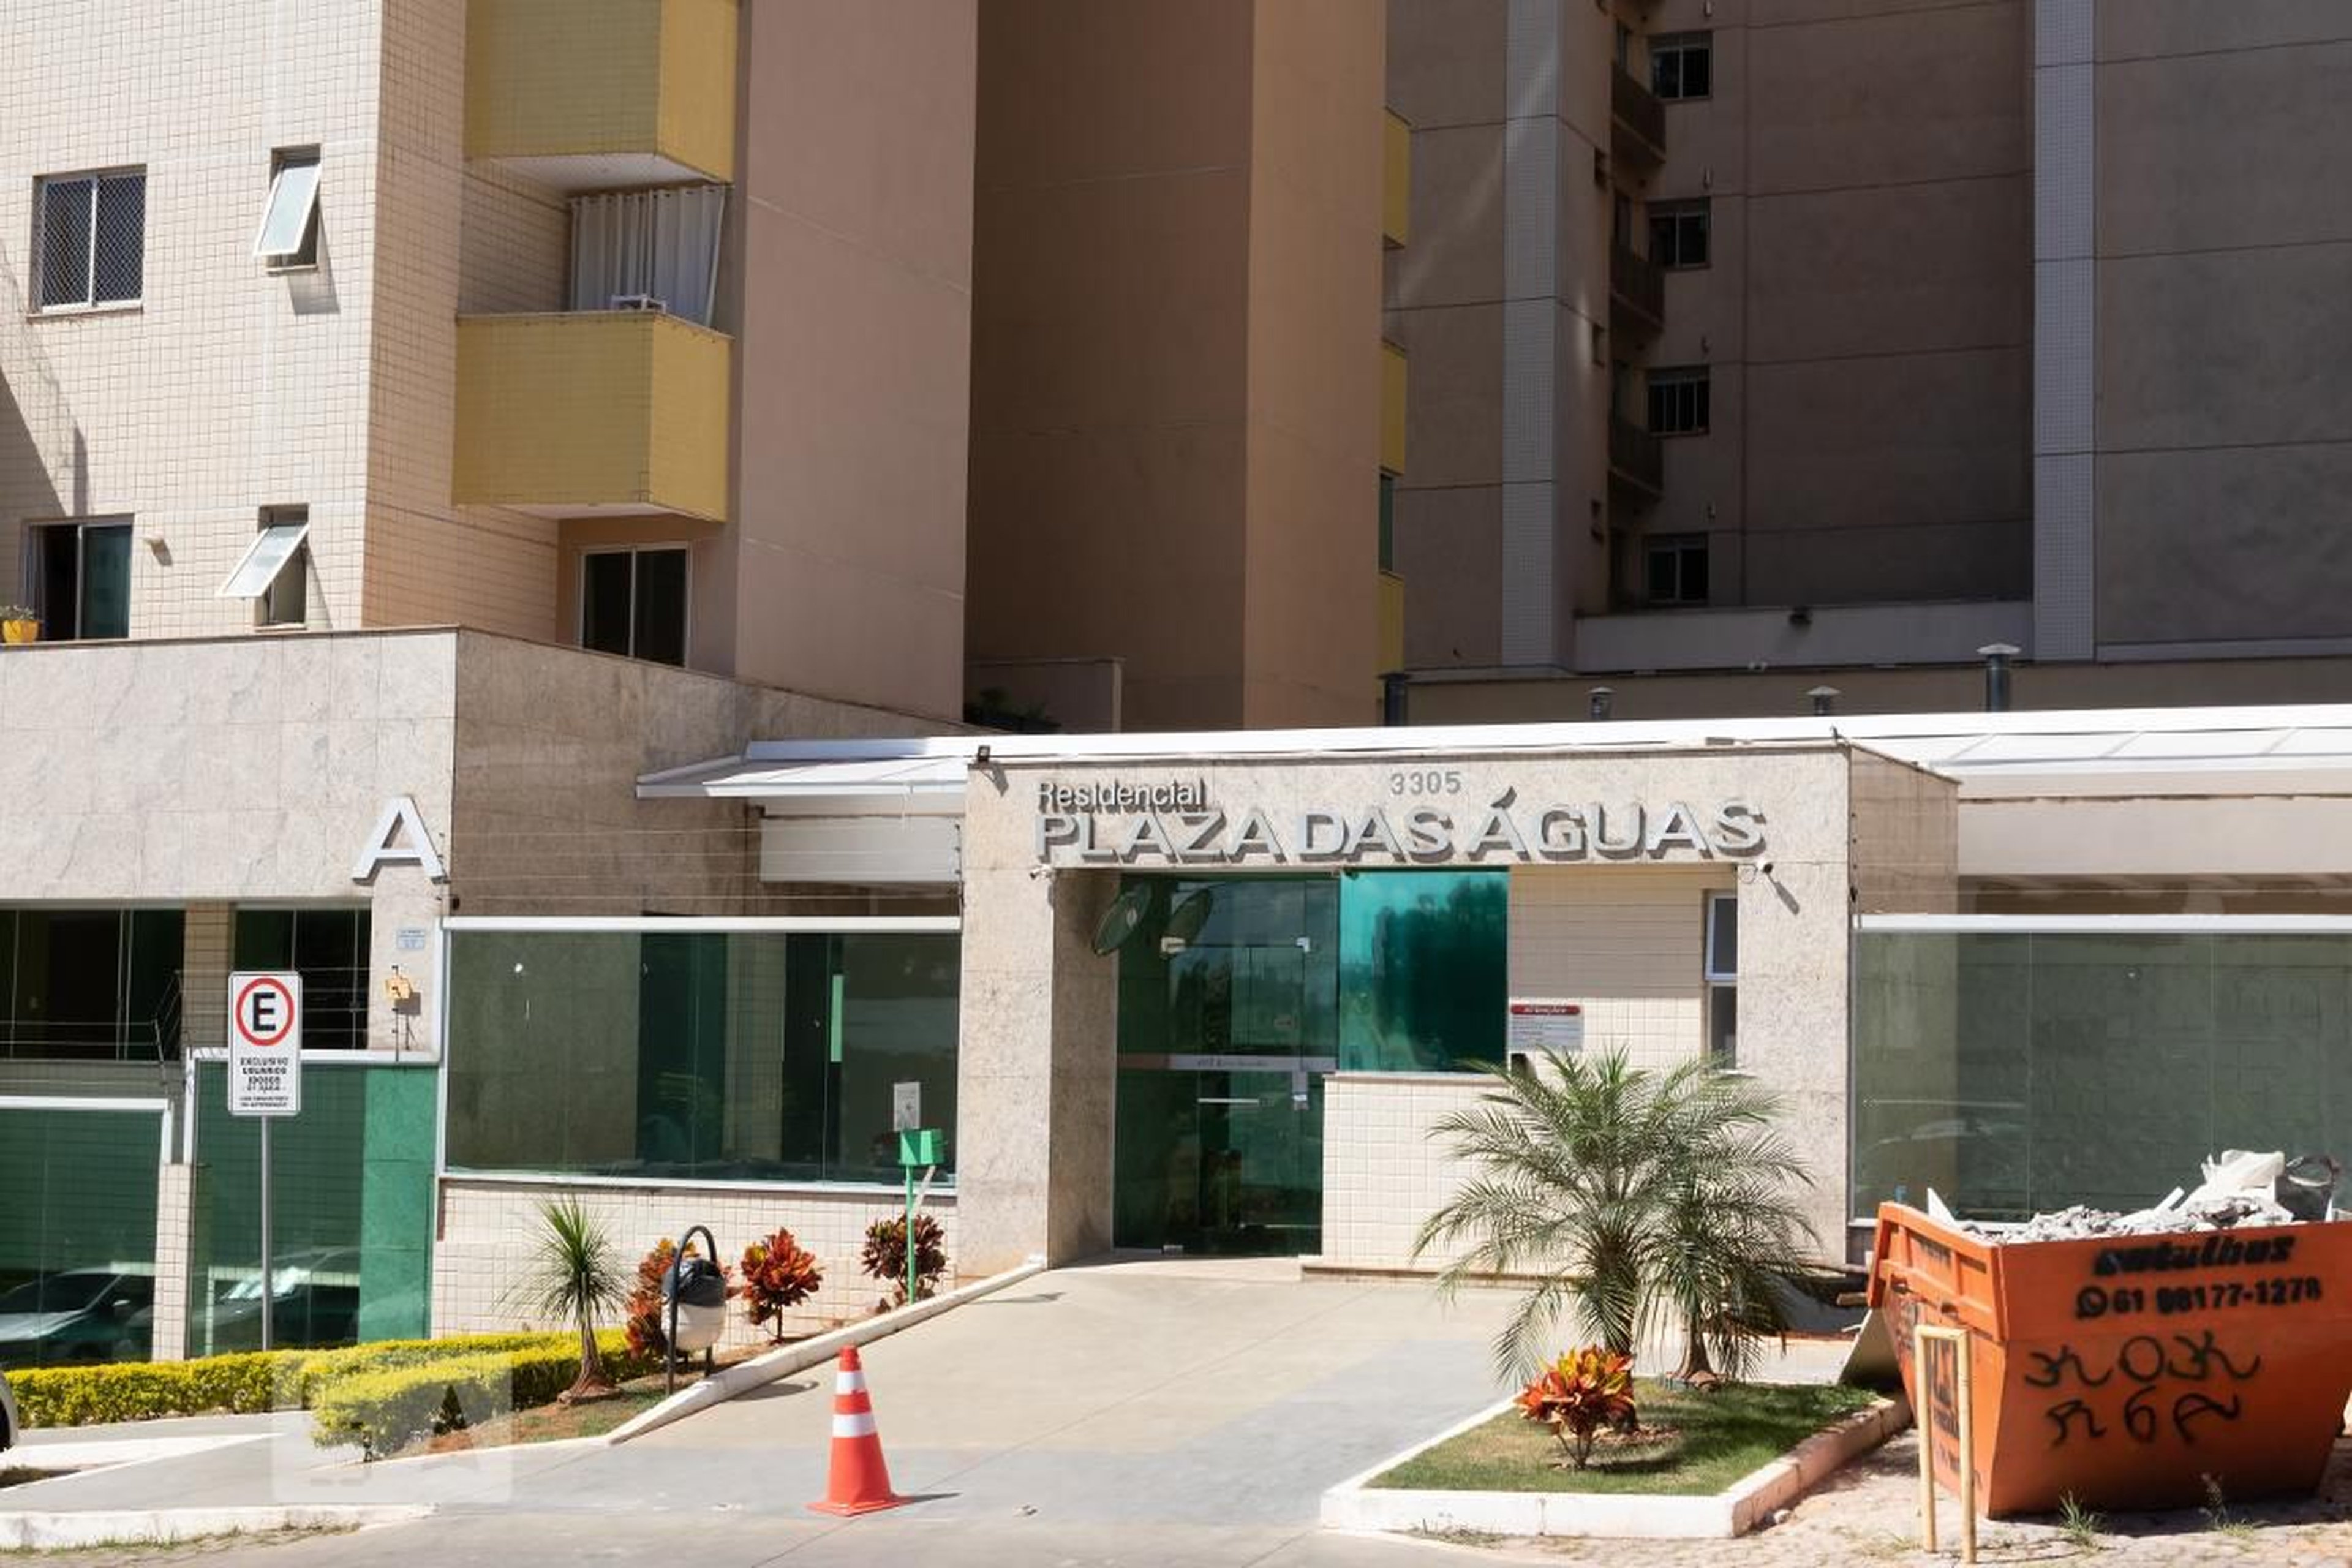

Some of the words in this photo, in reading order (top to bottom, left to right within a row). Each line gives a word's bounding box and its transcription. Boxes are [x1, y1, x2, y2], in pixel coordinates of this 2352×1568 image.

[1036, 778, 1206, 812] Residencial
[1390, 771, 1462, 795] 3305
[352, 795, 447, 885] A
[1034, 810, 1286, 863] PLAZA
[1296, 806, 1455, 863] DAS
[1468, 786, 1767, 861] ÁGUAS
[253, 992, 276, 1031] E
